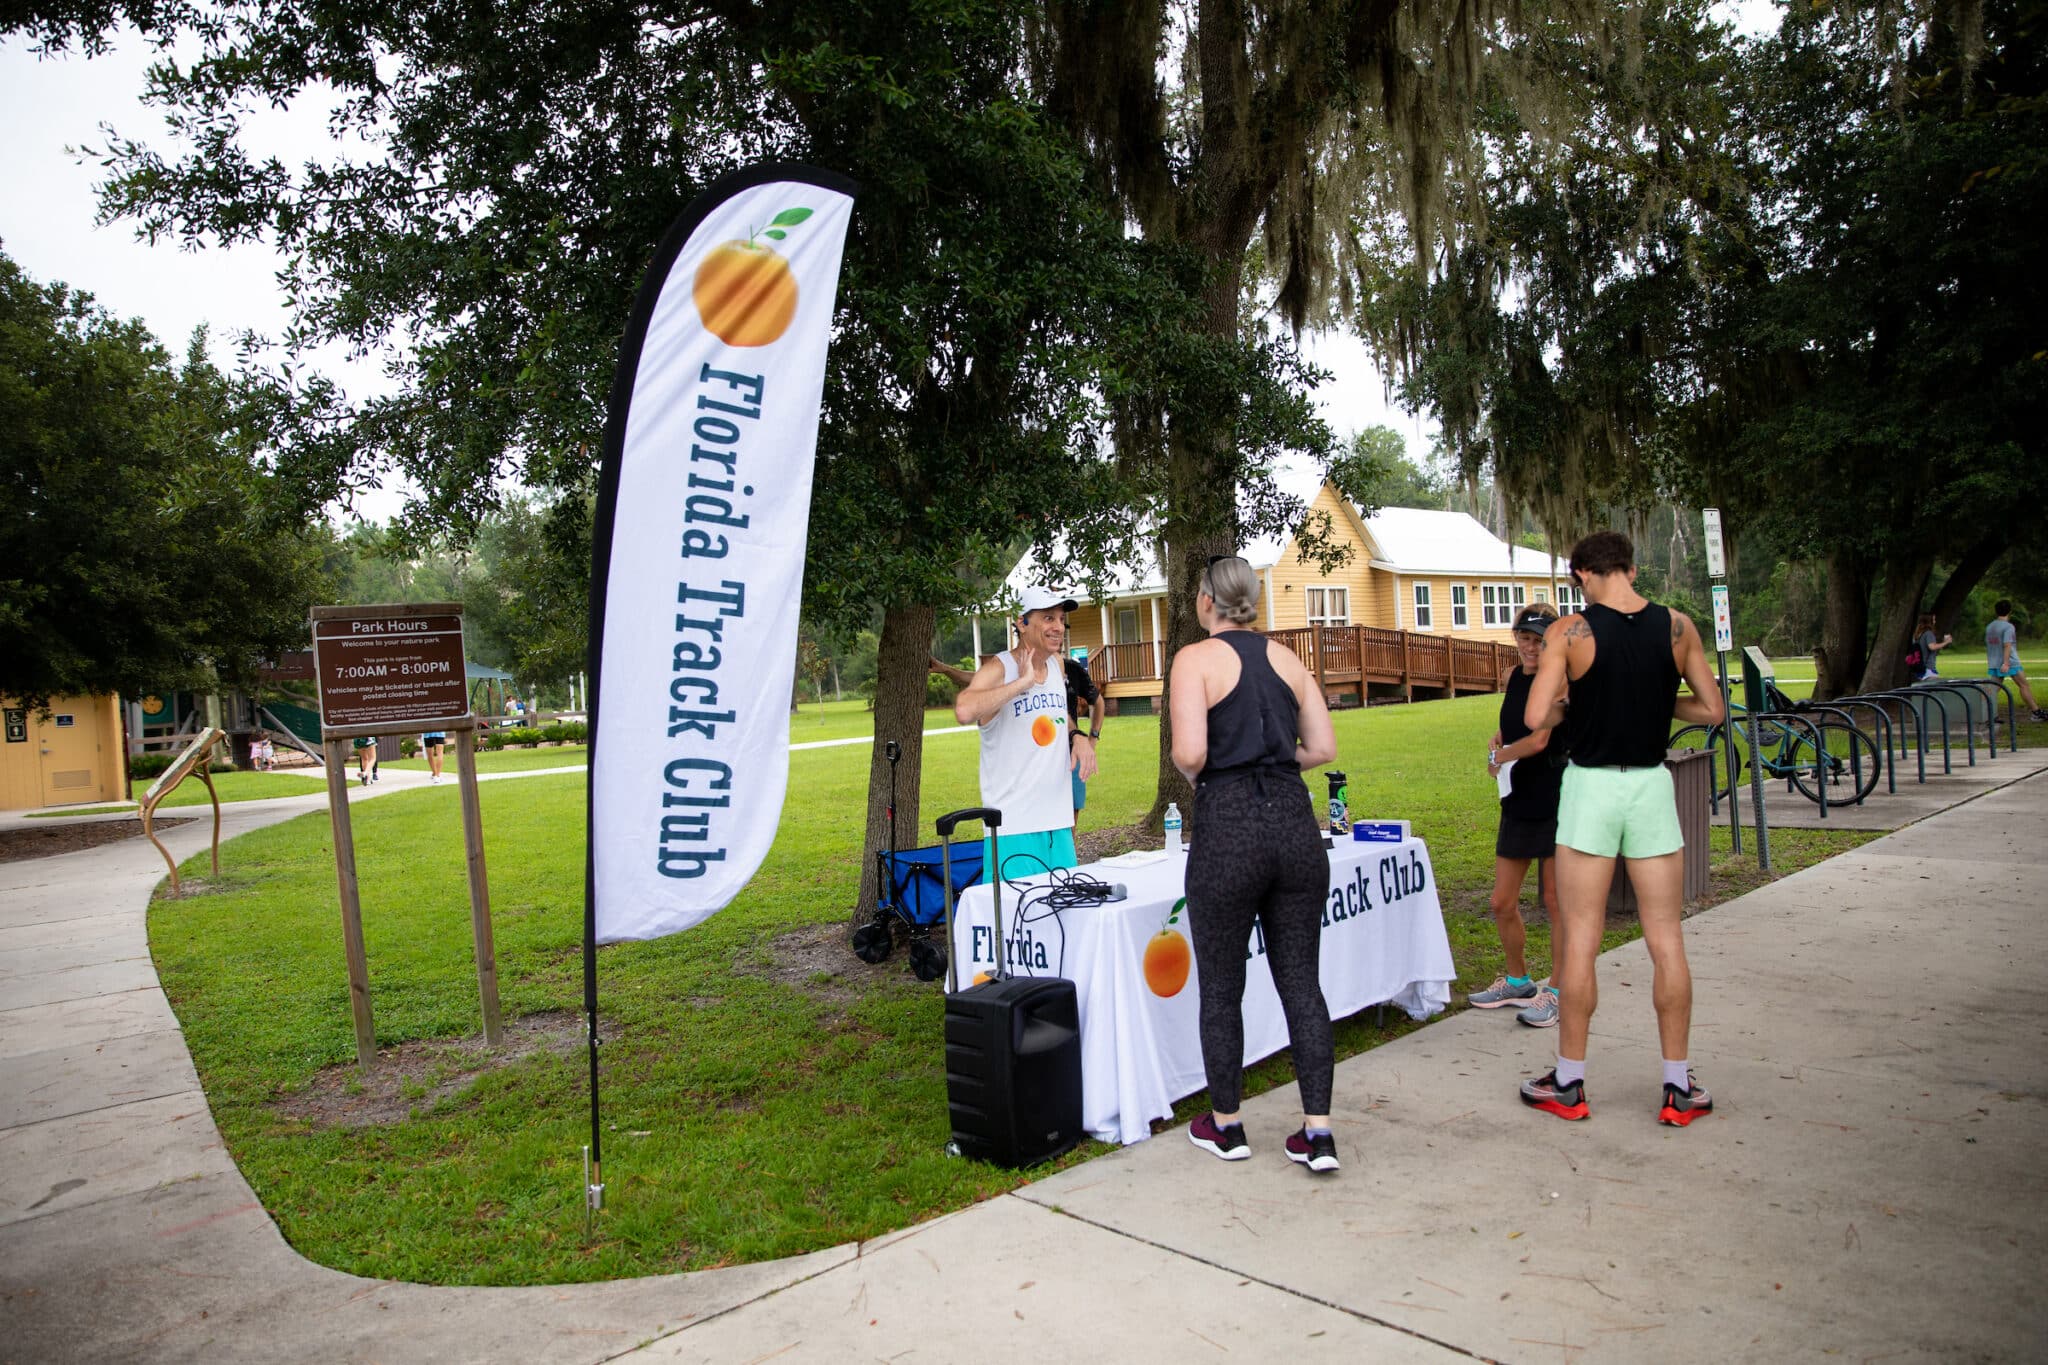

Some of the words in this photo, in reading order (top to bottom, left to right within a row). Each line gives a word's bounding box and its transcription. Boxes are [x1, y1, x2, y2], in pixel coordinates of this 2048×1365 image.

[681, 362, 765, 559] Florida
[352, 621, 384, 633] Park
[388, 620, 428, 632] Hours
[341, 640, 374, 648] Welcome
[384, 639, 399, 648] your
[401, 637, 424, 645] nature
[424, 636, 440, 645] park
[336, 665, 387, 679] 7:00AM
[401, 661, 450, 675] 8:00PM
[667, 580, 746, 740] Track
[327, 686, 357, 695] Vehicles
[359, 686, 374, 694] may
[385, 682, 413, 690] ticketed
[444, 679, 461, 687] after
[362, 692, 387, 701] posted
[388, 690, 413, 699] closing
[413, 689, 429, 697] time
[1013, 693, 1066, 718] FLORID
[657, 758, 733, 879] Club
[1322, 866, 1373, 928] rack
[1380, 850, 1426, 905] Club
[972, 925, 1049, 969] Flrida
